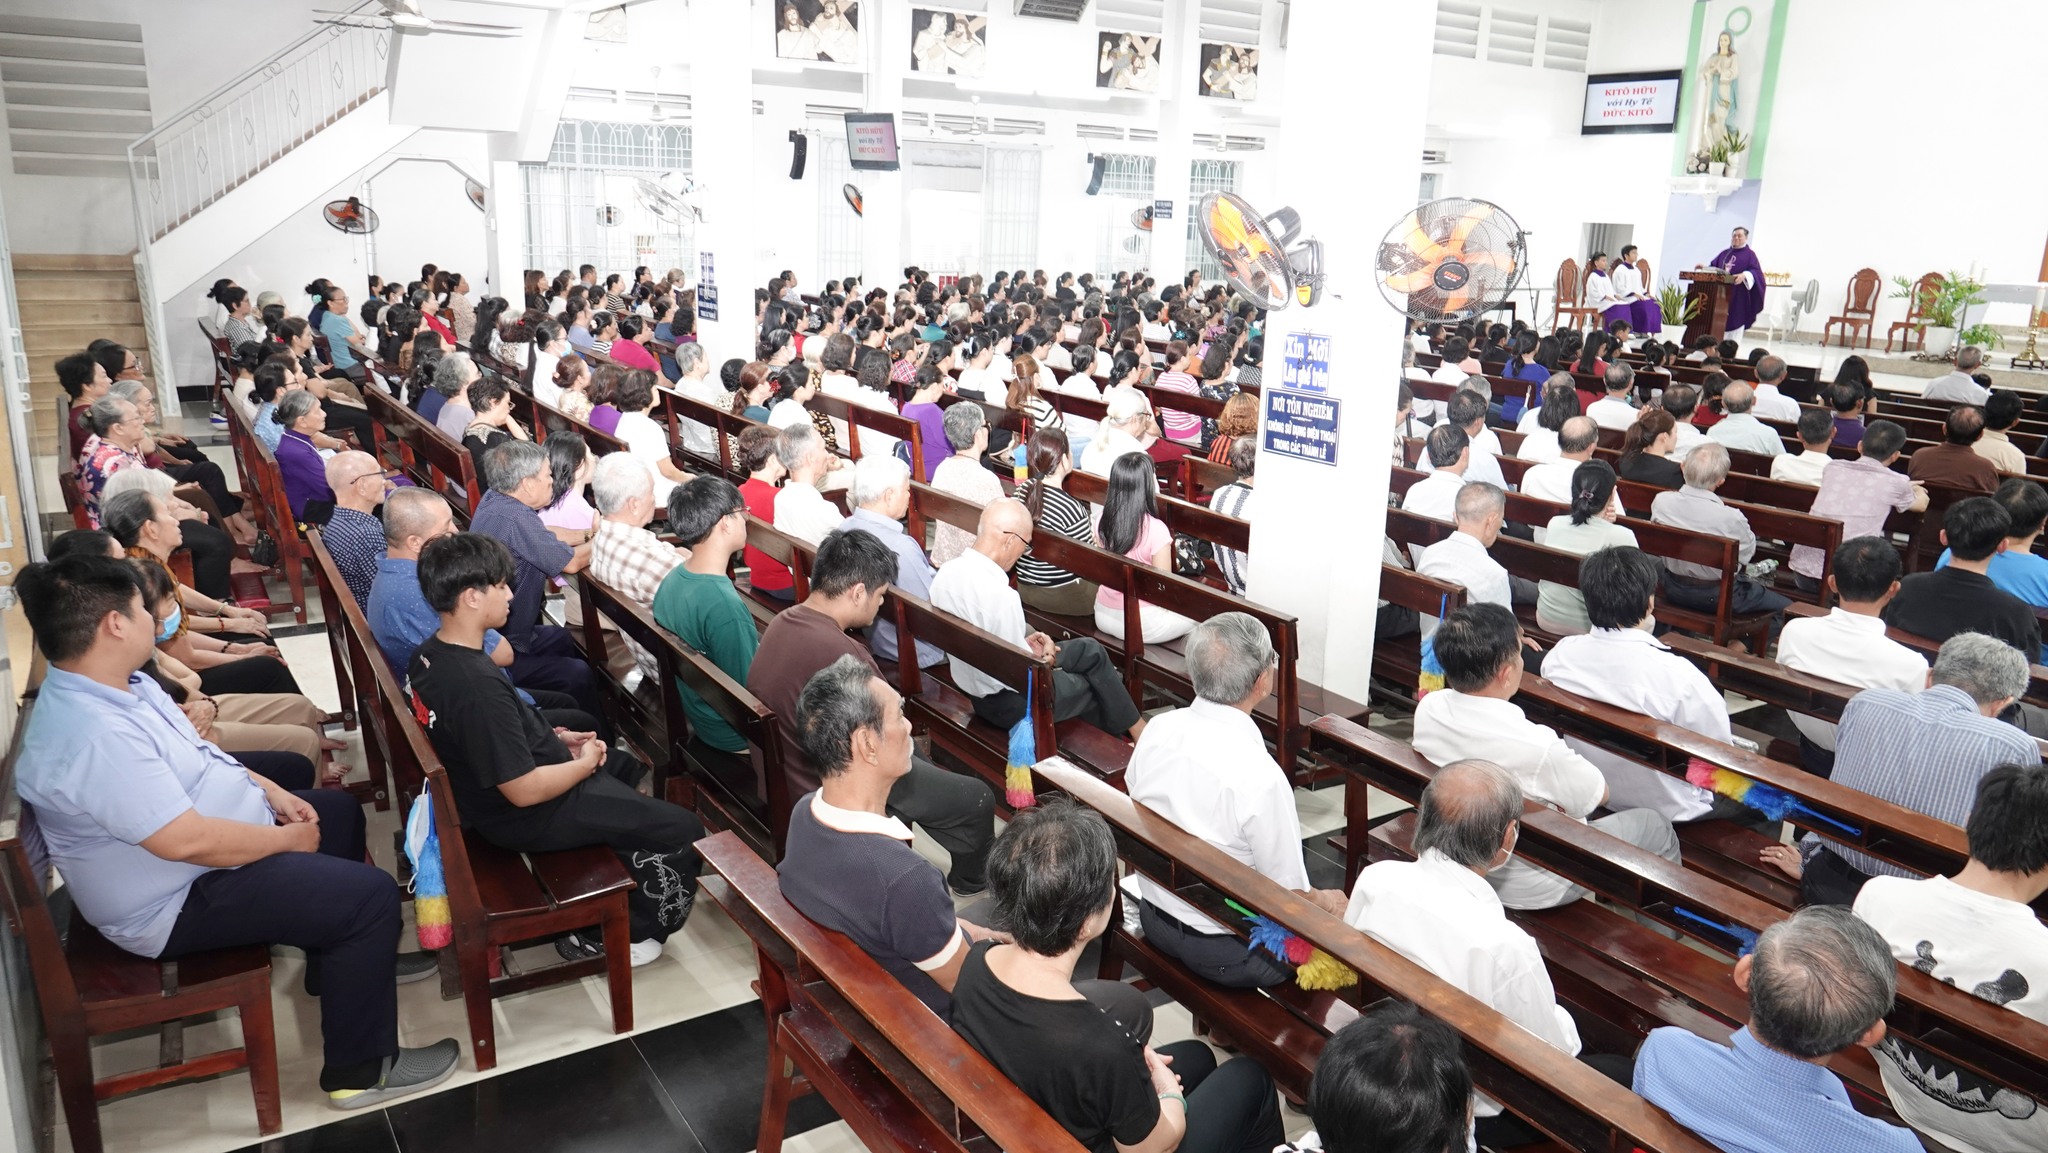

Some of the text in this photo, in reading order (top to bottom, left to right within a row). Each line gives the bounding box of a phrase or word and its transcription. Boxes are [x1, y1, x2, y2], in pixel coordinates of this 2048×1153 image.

[1605, 86, 1657, 96] KITÔ HỮU
[1607, 97, 1654, 108] với Hy Tế
[1603, 107, 1654, 117] ĐỨC KITÔ
[1286, 336, 1304, 358] Xin
[1272, 395, 1333, 421] NƠI TÔN NGHIÊM
[1267, 419, 1284, 433] KHÔNG
[1291, 424, 1307, 440] DỤNG
[1320, 427, 1337, 446] THOẠI
[1273, 438, 1290, 452] TRONG
